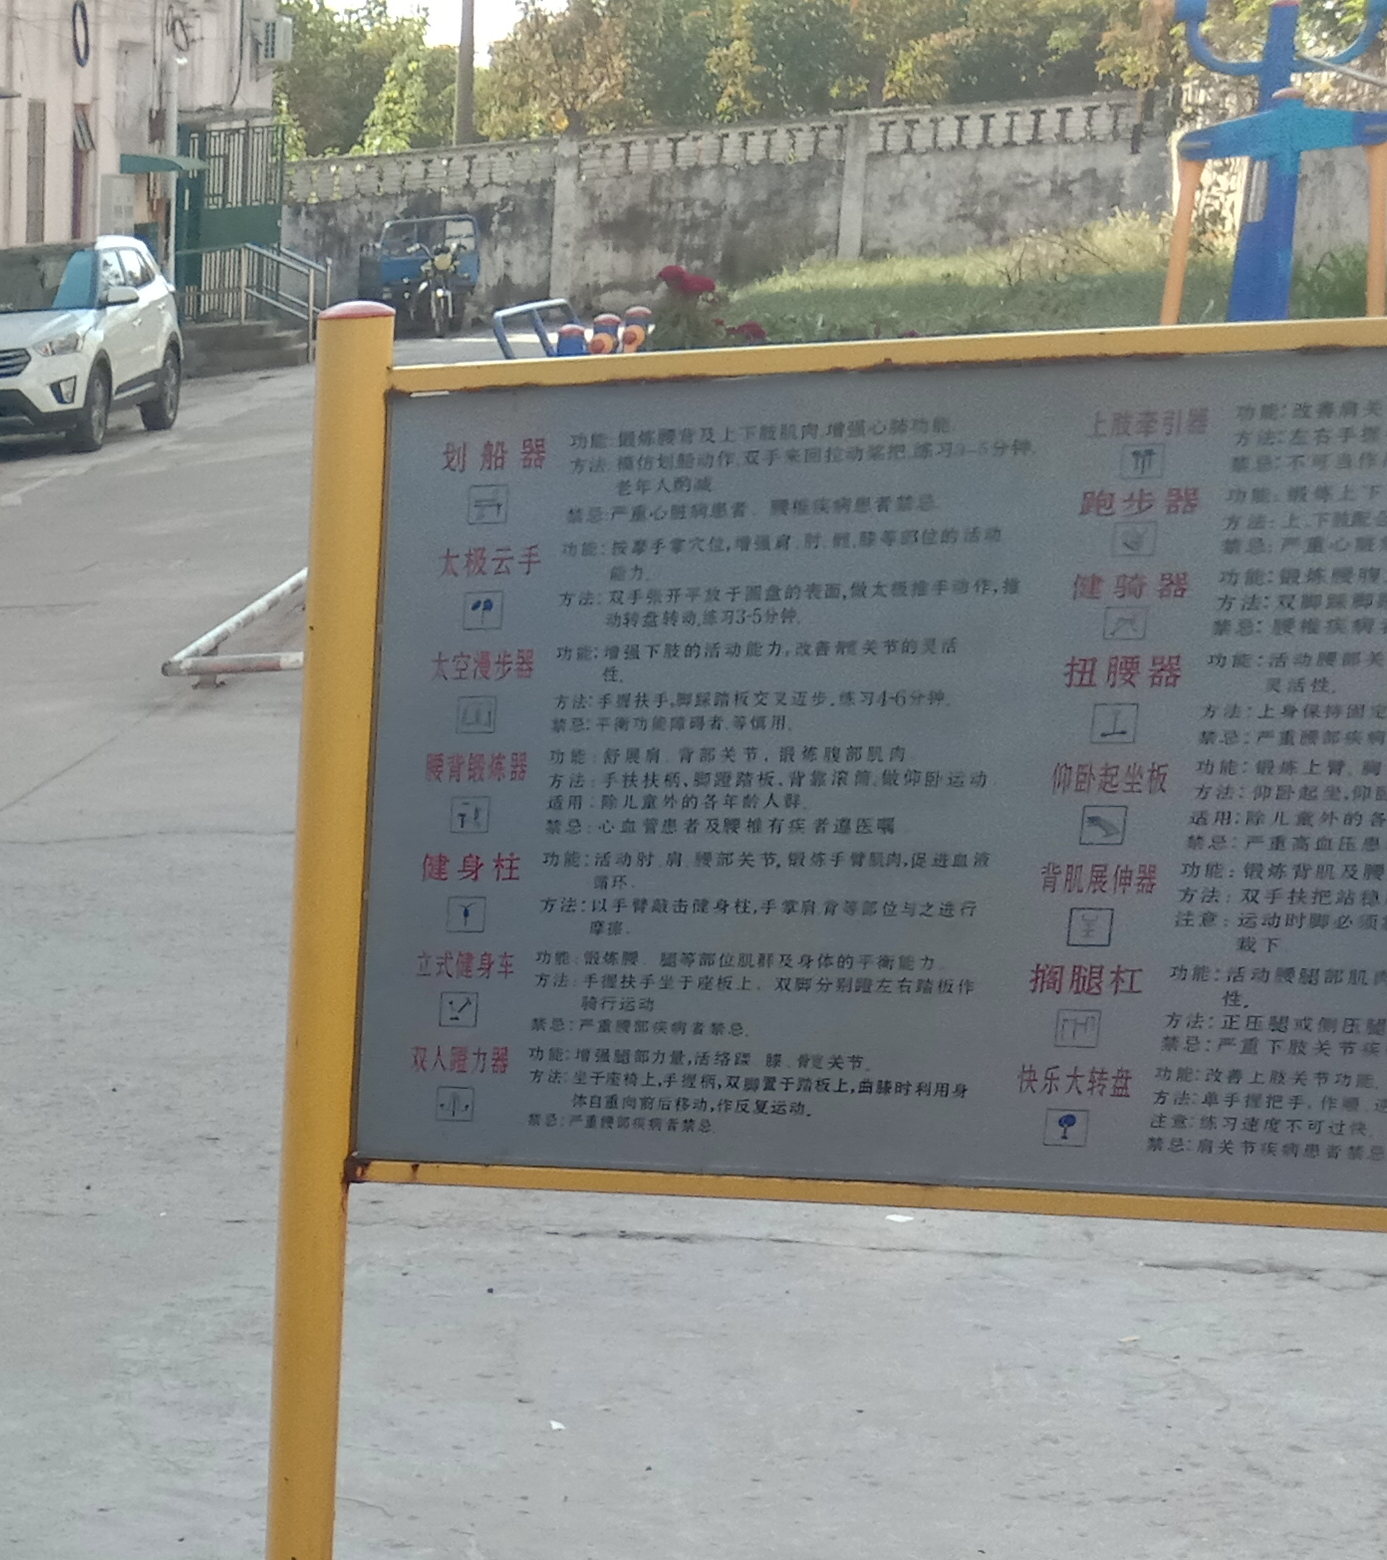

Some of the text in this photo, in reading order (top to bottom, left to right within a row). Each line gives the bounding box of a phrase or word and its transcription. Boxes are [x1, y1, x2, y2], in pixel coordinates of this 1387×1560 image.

[443, 438, 546, 473] 划船器
[439, 544, 541, 577] 太极云手
[431, 649, 535, 684] 太空漫步器
[425, 752, 528, 783] 腰背锻炼器
[422, 852, 521, 882] 健身柱
[415, 951, 515, 979] 立式健身车
[411, 1045, 510, 1074] 双人蹬力器
